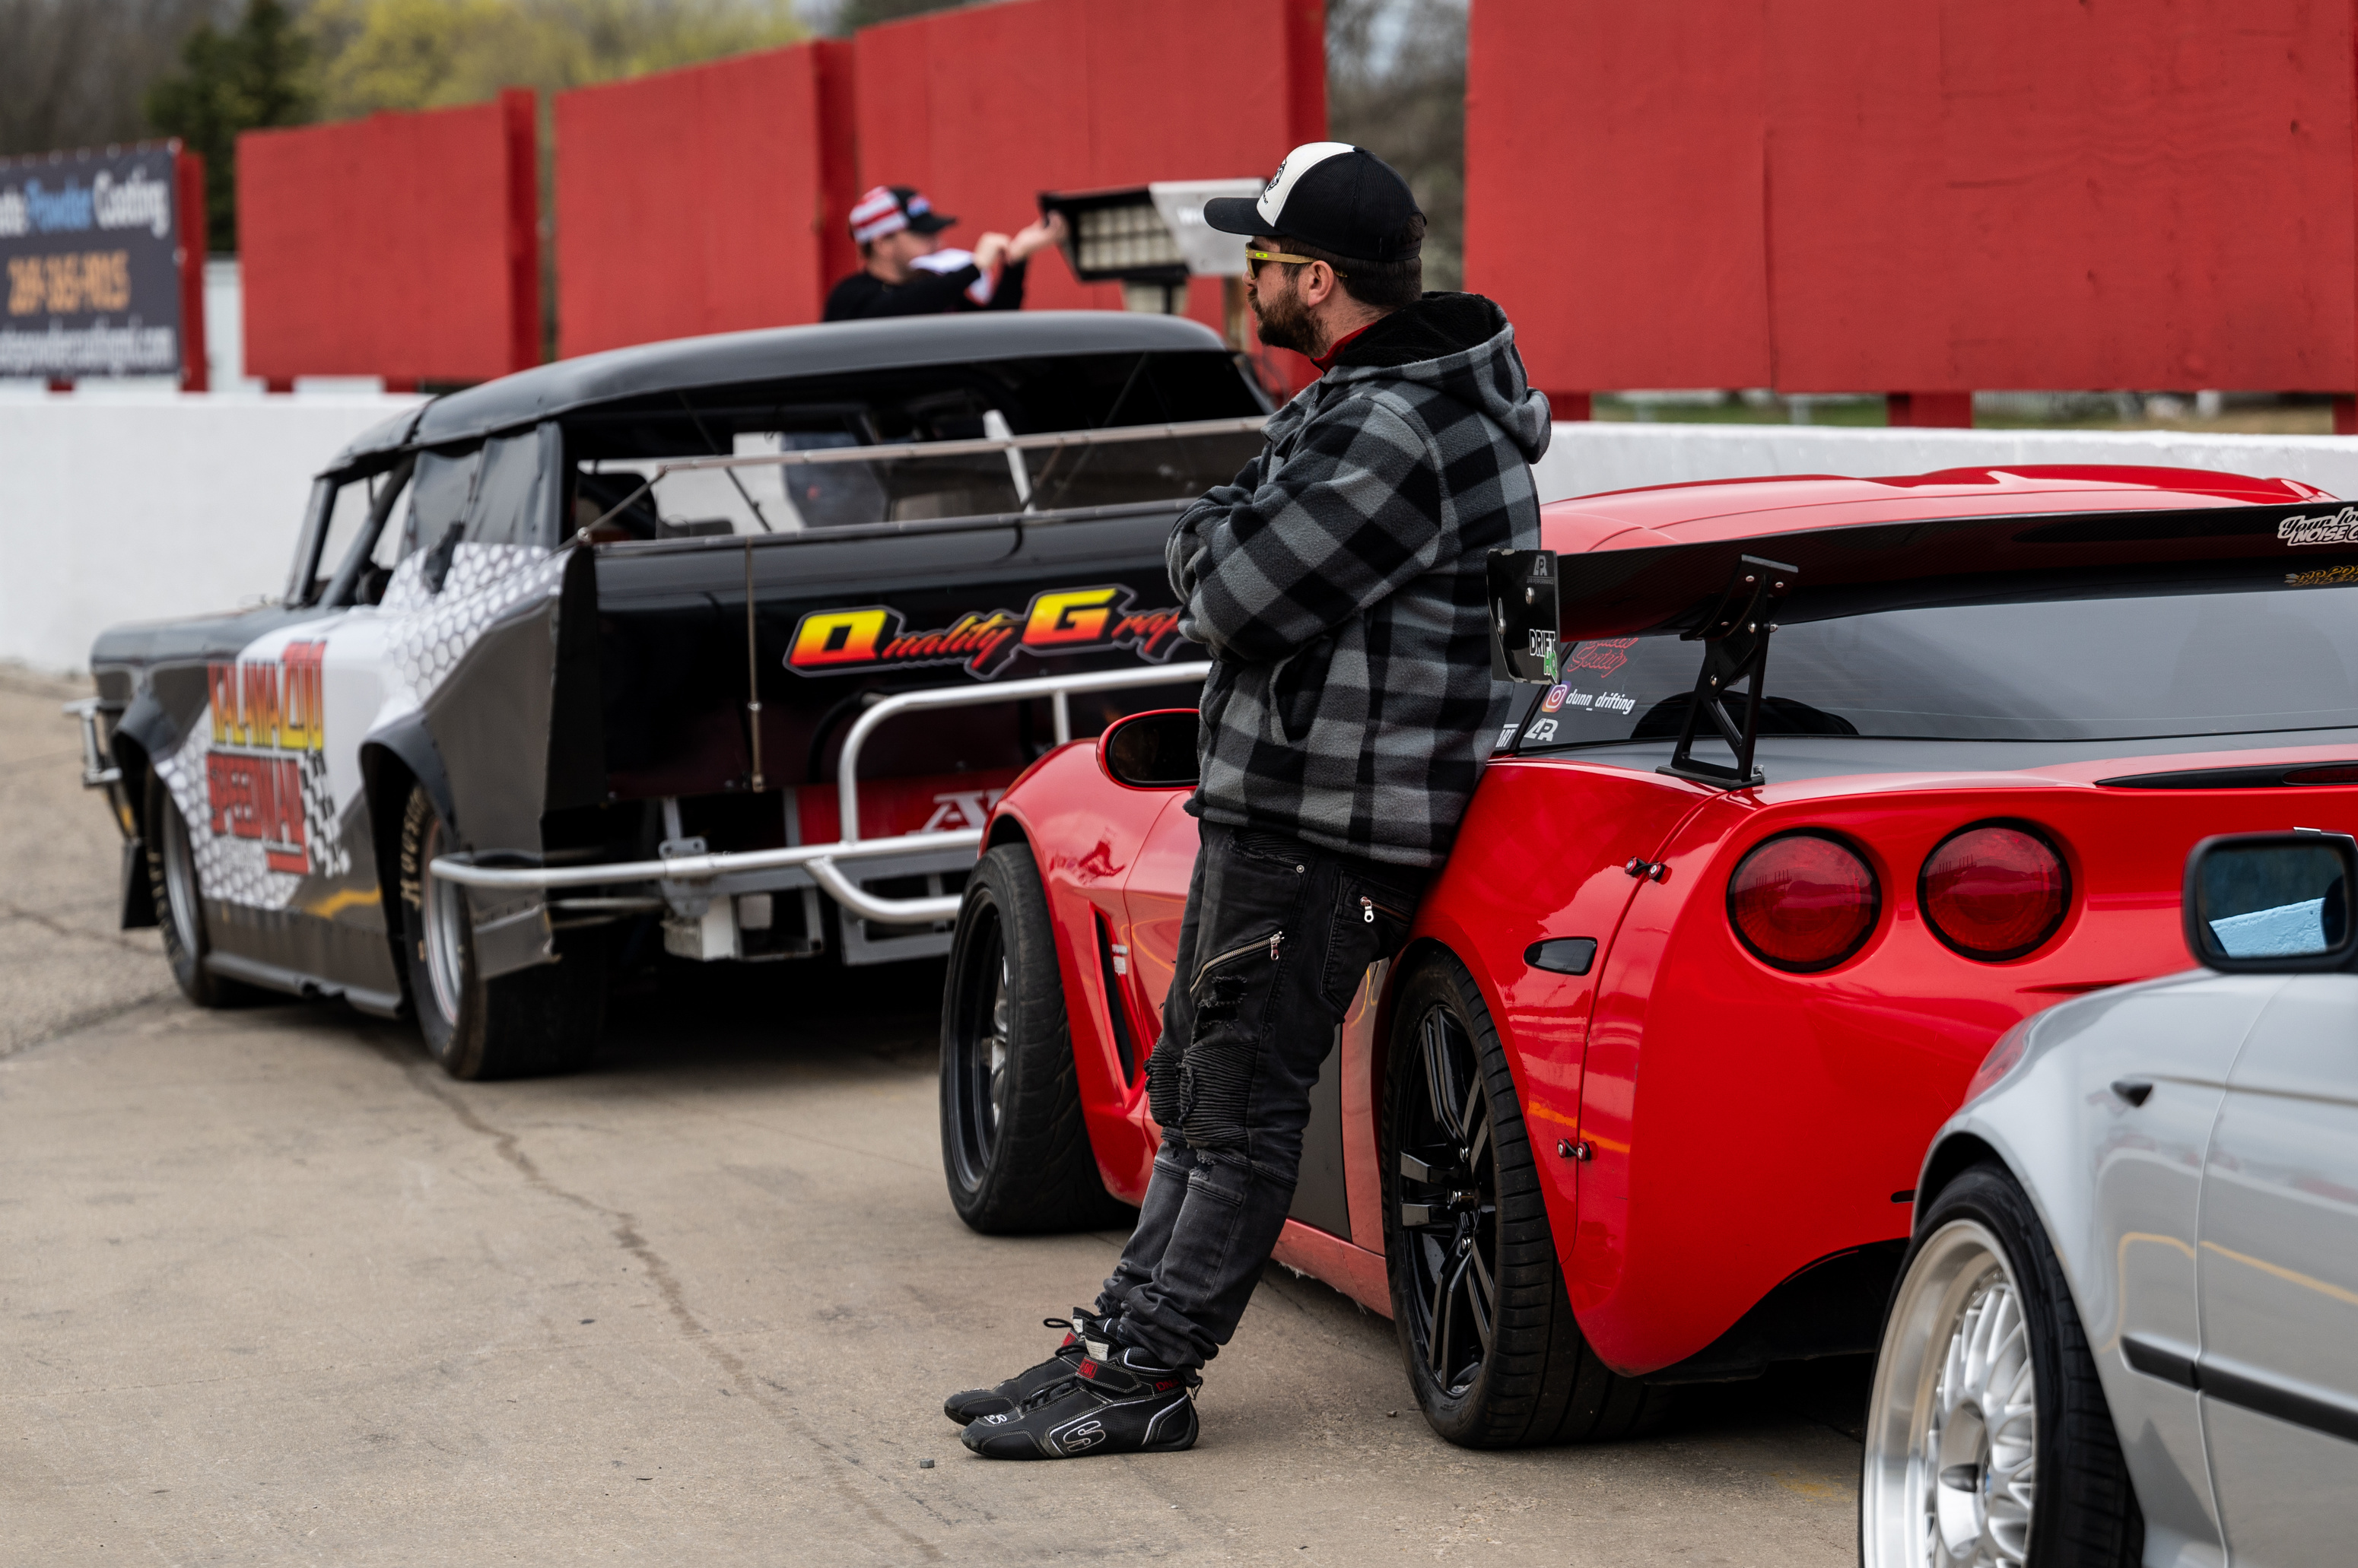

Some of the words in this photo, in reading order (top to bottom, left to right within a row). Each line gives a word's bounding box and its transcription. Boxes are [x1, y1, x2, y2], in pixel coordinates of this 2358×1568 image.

[2291, 524, 2350, 544] NOISE
[789, 608, 1015, 670] Quality
[1022, 588, 1181, 655] Grap
[1529, 629, 1556, 657] DRIFT
[1543, 650, 1558, 684] HQ
[1565, 688, 1635, 715] dunn_drifting
[1382, 1078, 1394, 1234] MICHELIN
